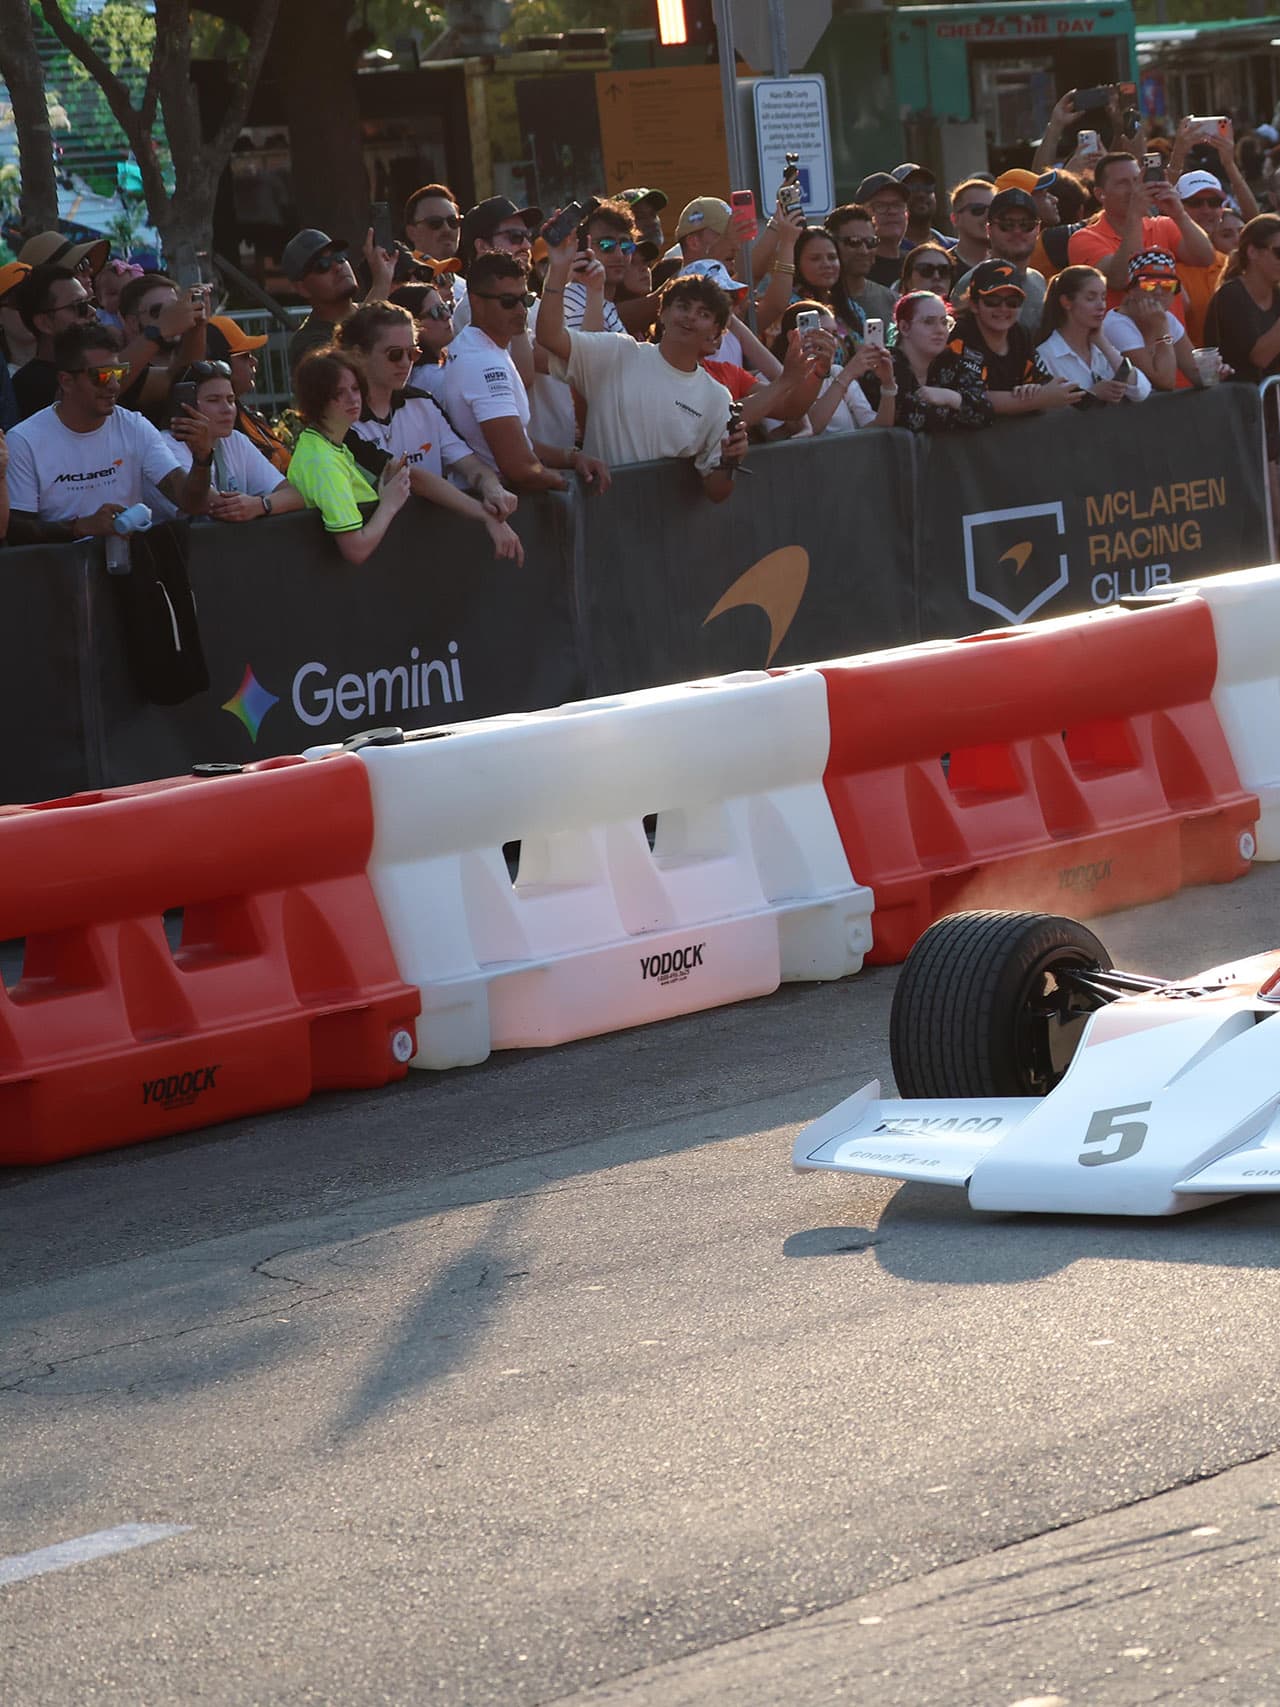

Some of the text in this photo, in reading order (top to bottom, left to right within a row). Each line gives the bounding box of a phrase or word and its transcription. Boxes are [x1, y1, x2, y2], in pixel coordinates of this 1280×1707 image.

[1056, 18, 1095, 33] DAY
[54, 467, 116, 483] McLaren
[1088, 519, 1202, 566] RACING
[1091, 563, 1171, 604] CLUB
[292, 641, 464, 726] Gemini
[1059, 859, 1113, 890] YODOCK
[640, 943, 703, 980] YODOCK
[143, 1067, 217, 1104] YODOCK
[872, 1116, 1004, 1134] TEXACO
[1078, 1101, 1152, 1167] 5
[848, 1151, 941, 1168] GOODYEAR
